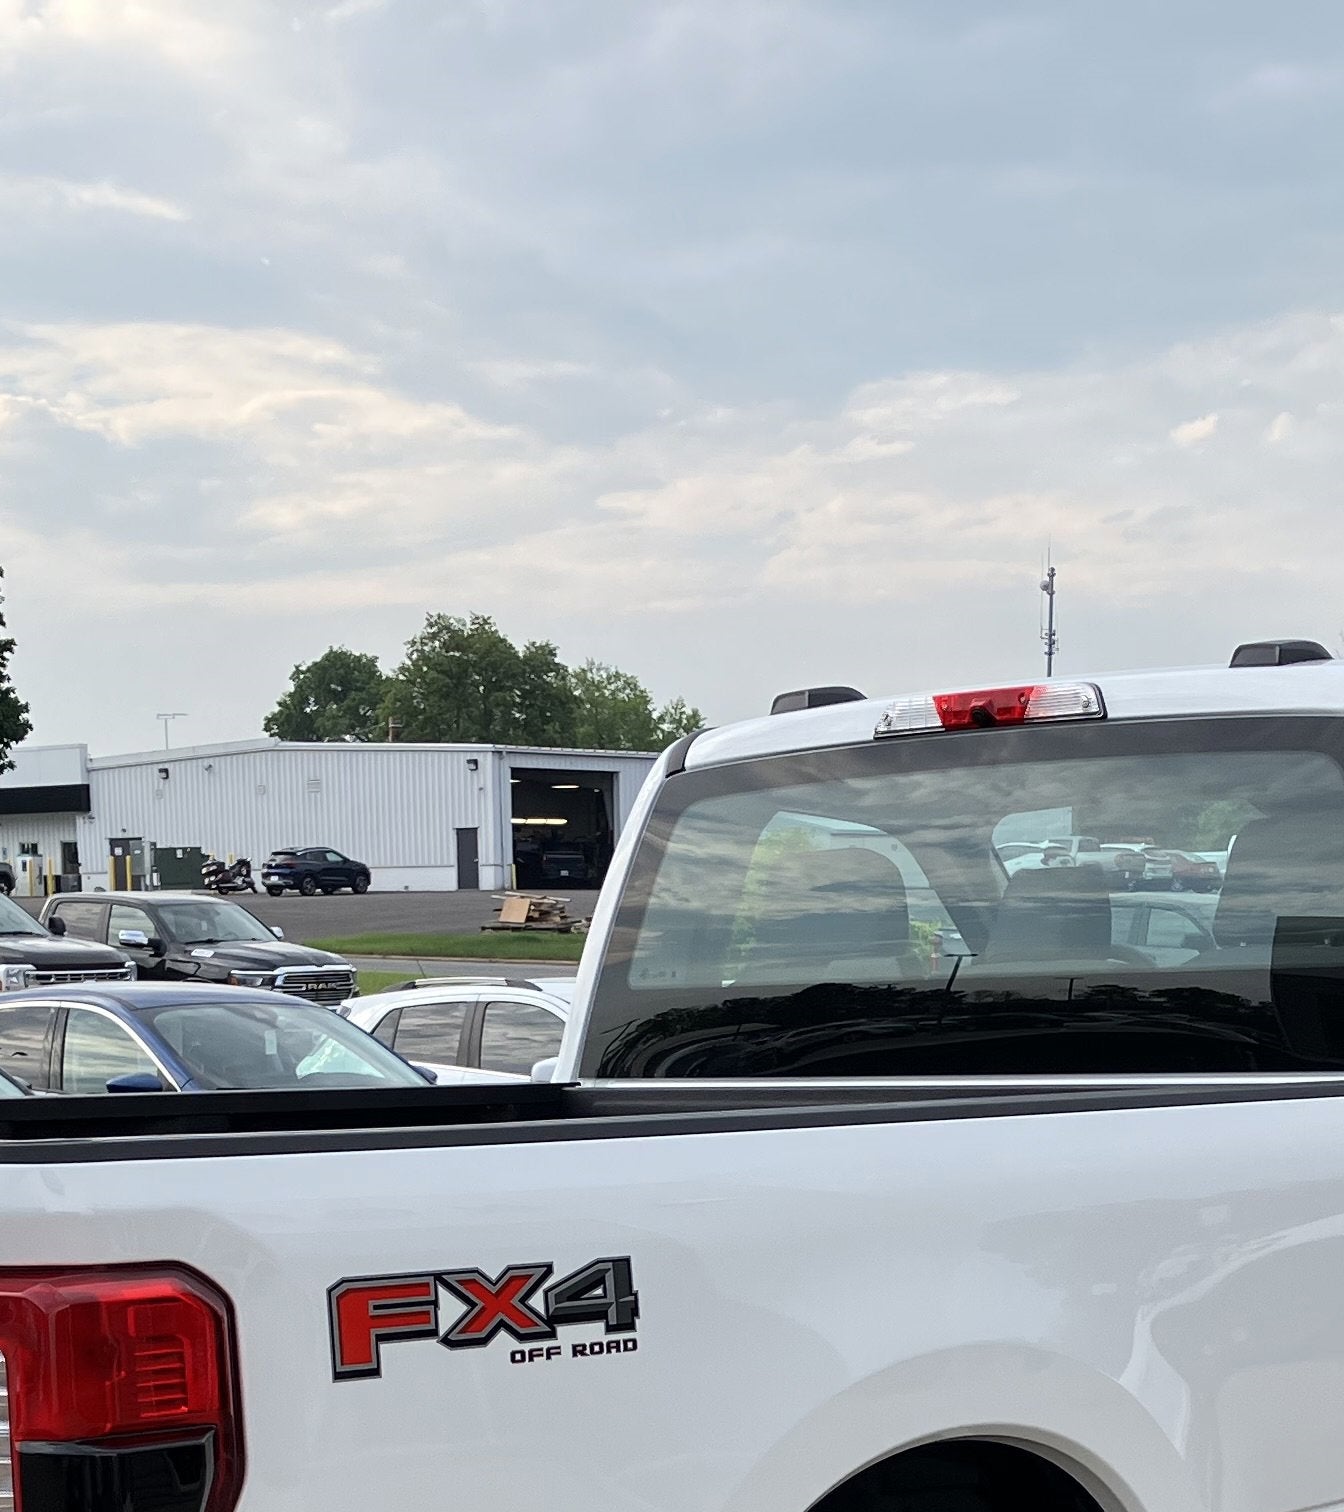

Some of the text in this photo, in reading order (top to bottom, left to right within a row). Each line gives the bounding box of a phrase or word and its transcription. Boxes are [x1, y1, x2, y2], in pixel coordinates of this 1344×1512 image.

[326, 1255, 641, 1383] FX4
[509, 1337, 639, 1364] OFF ROAD
